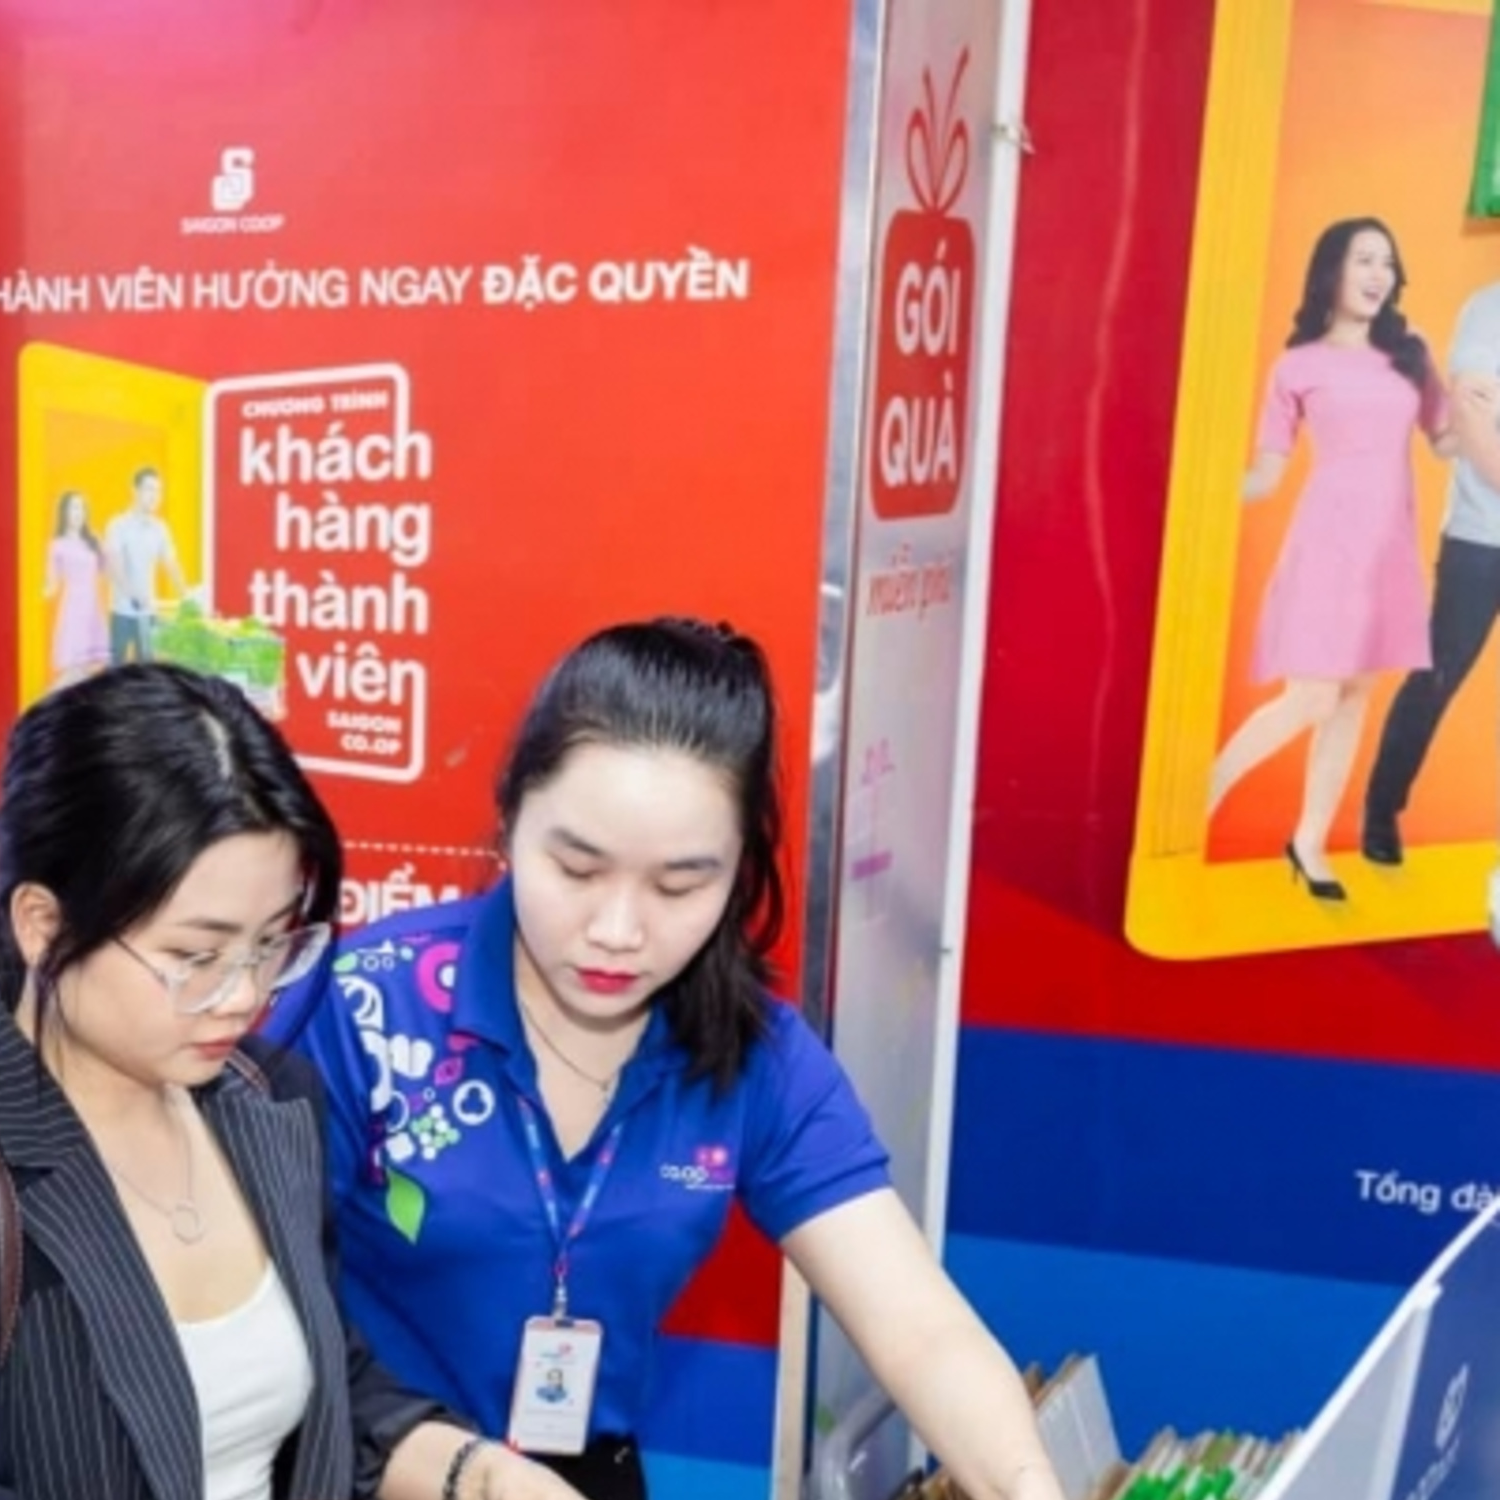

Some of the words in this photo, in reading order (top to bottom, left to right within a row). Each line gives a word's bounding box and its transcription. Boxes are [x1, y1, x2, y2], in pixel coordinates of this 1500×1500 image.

[97, 264, 183, 311] VIÊN
[193, 257, 348, 309] HƯỞNG
[359, 264, 472, 307] NGAY
[481, 254, 578, 311] ĐẶC
[588, 245, 751, 303] QUYỀN
[895, 240, 961, 356] GÓI
[239, 421, 434, 486] khách
[878, 371, 957, 489] QUÀ
[274, 489, 431, 568] hàng
[247, 567, 430, 635] thành
[295, 641, 428, 706] viên
